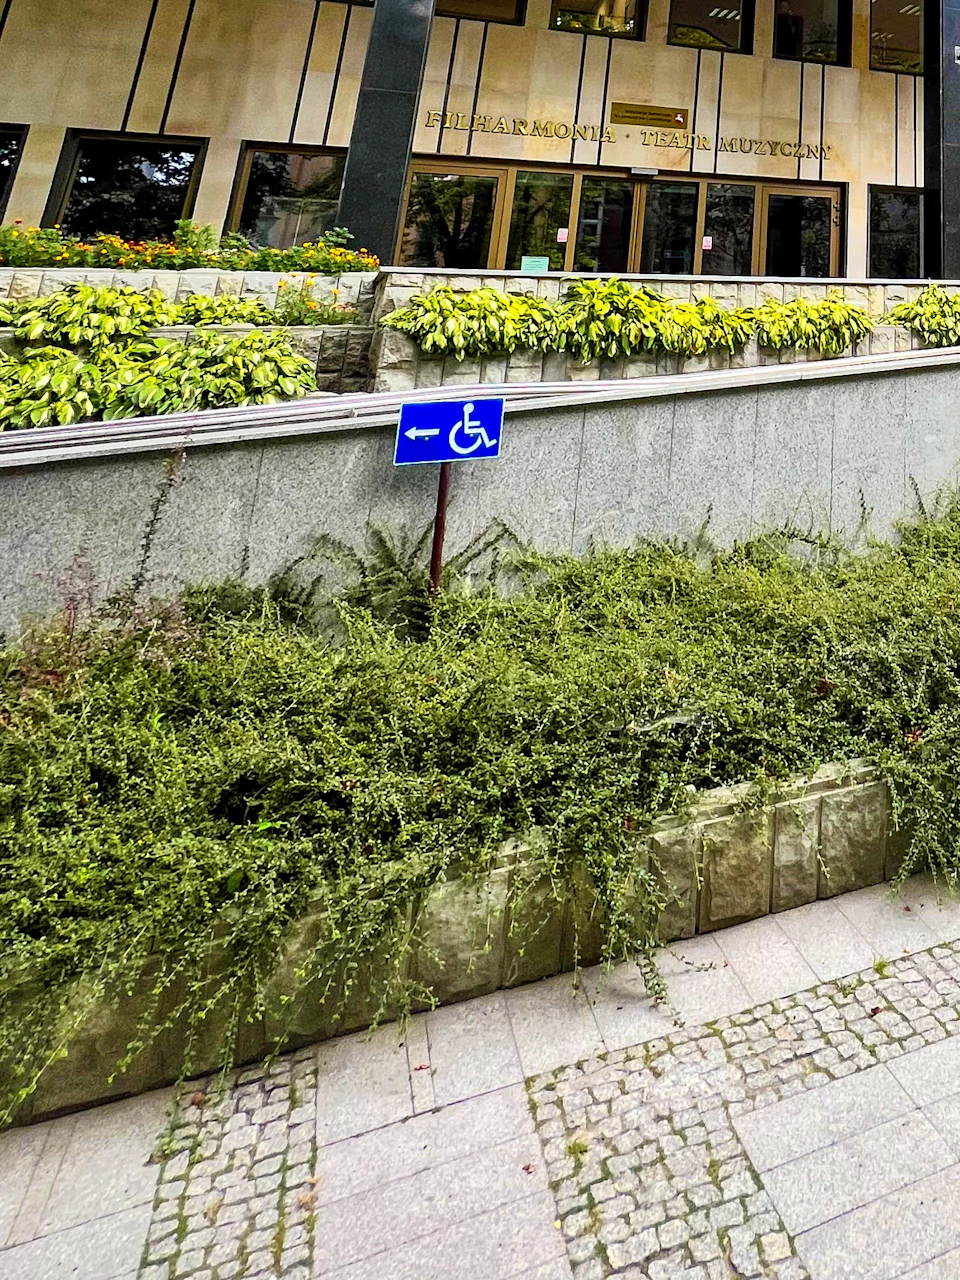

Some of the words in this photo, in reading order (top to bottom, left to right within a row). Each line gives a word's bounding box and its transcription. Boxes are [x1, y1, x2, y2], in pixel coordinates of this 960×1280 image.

[425, 110, 616, 142] FILHARMONIA
[641, 129, 711, 150] TEATR
[718, 136, 832, 160] MUZYCZNY
